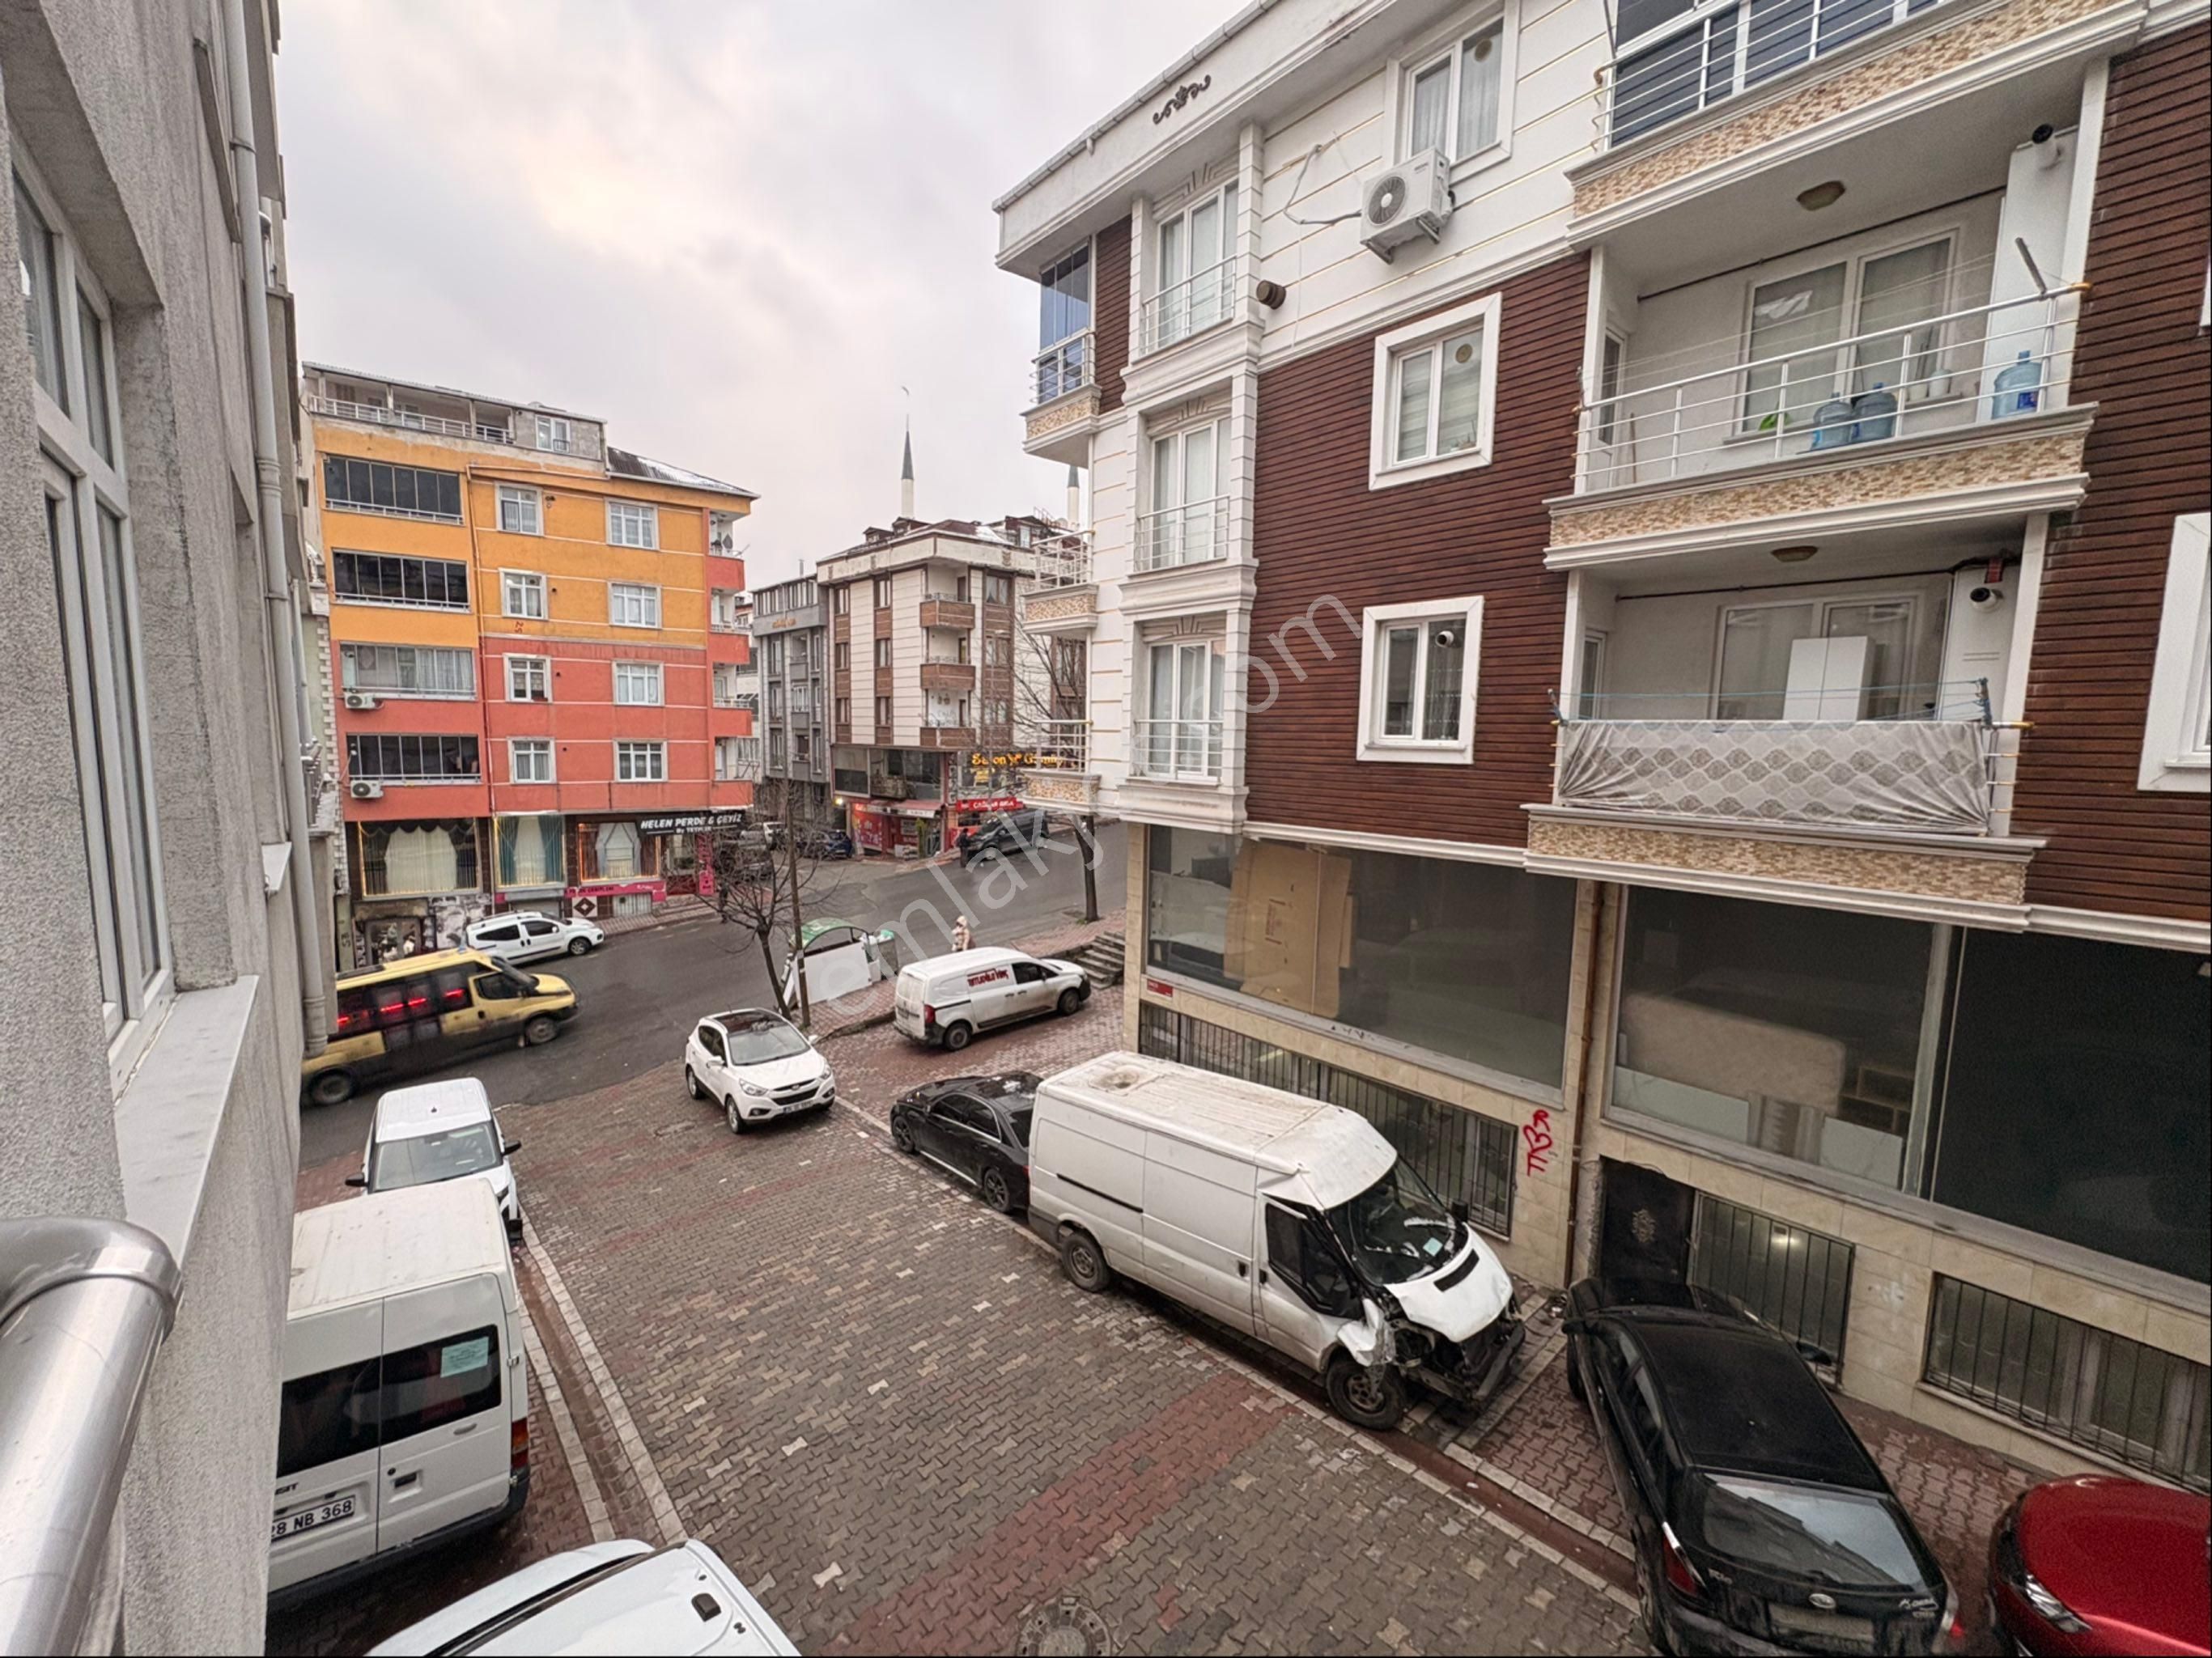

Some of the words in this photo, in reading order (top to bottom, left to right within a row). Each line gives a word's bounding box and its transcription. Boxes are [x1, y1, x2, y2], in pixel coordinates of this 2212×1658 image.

[640, 818, 673, 829] HELEN
[675, 816, 707, 827] PERDE
[293, 1512, 315, 1530] NB
[321, 1499, 353, 1520] 368
